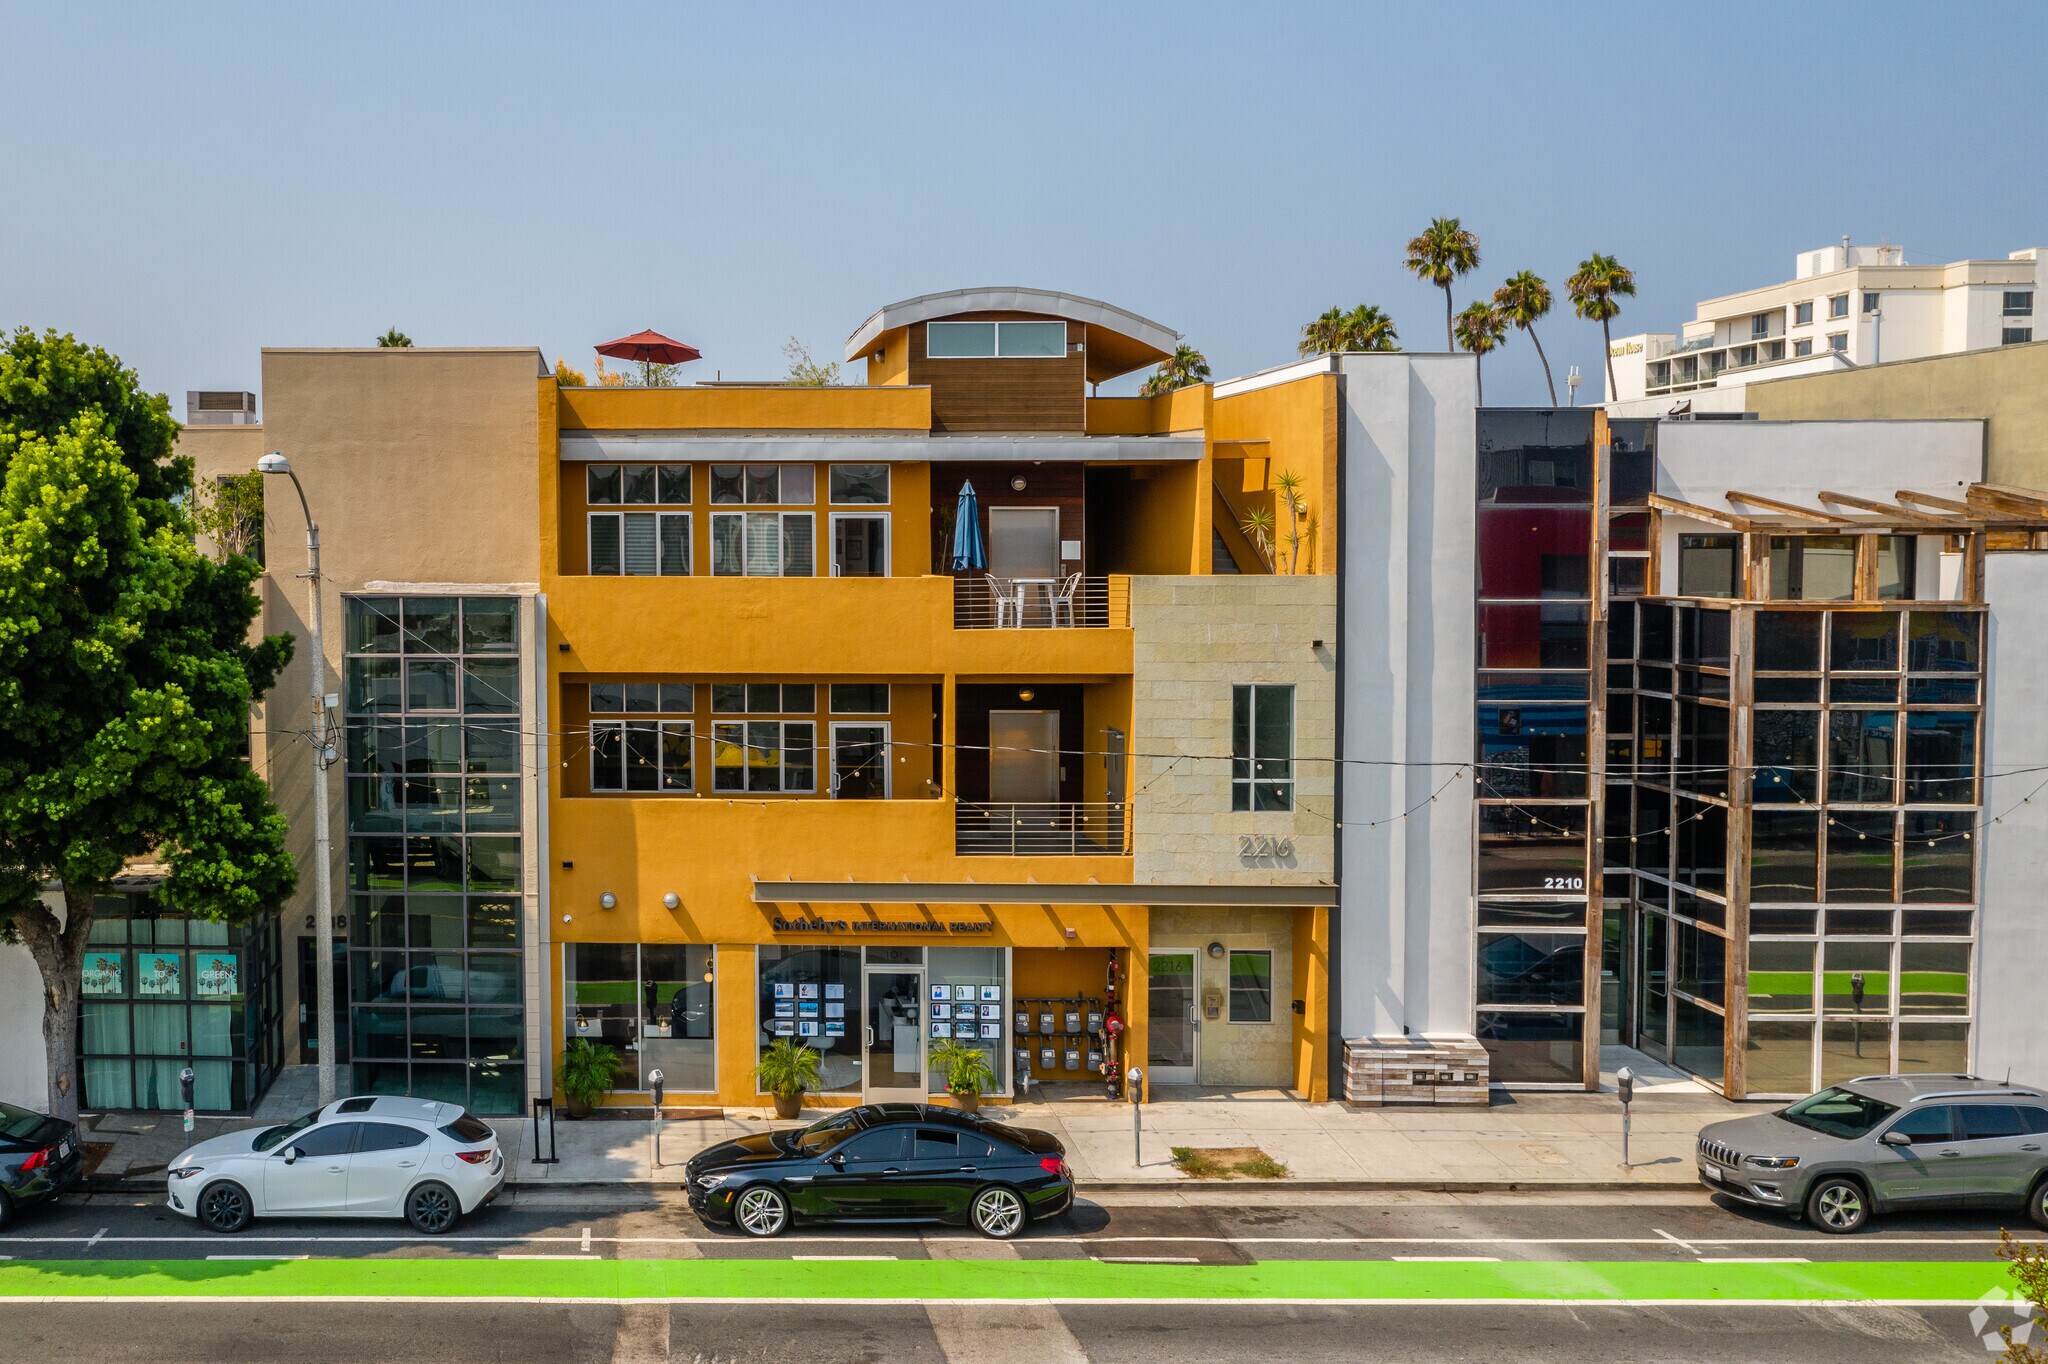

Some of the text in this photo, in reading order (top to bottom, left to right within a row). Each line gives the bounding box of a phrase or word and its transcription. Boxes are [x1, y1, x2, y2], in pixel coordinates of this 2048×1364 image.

[1236, 834, 1289, 857] 2216
[1544, 877, 1583, 889] 2210
[306, 914, 347, 929] 218
[773, 917, 994, 934] Sotheby's INTERNATIONAL REALTY
[1153, 960, 1183, 972] 2216
[82, 969, 121, 978] ORGANIC
[153, 970, 166, 978] TO
[201, 970, 233, 979] GREEN
